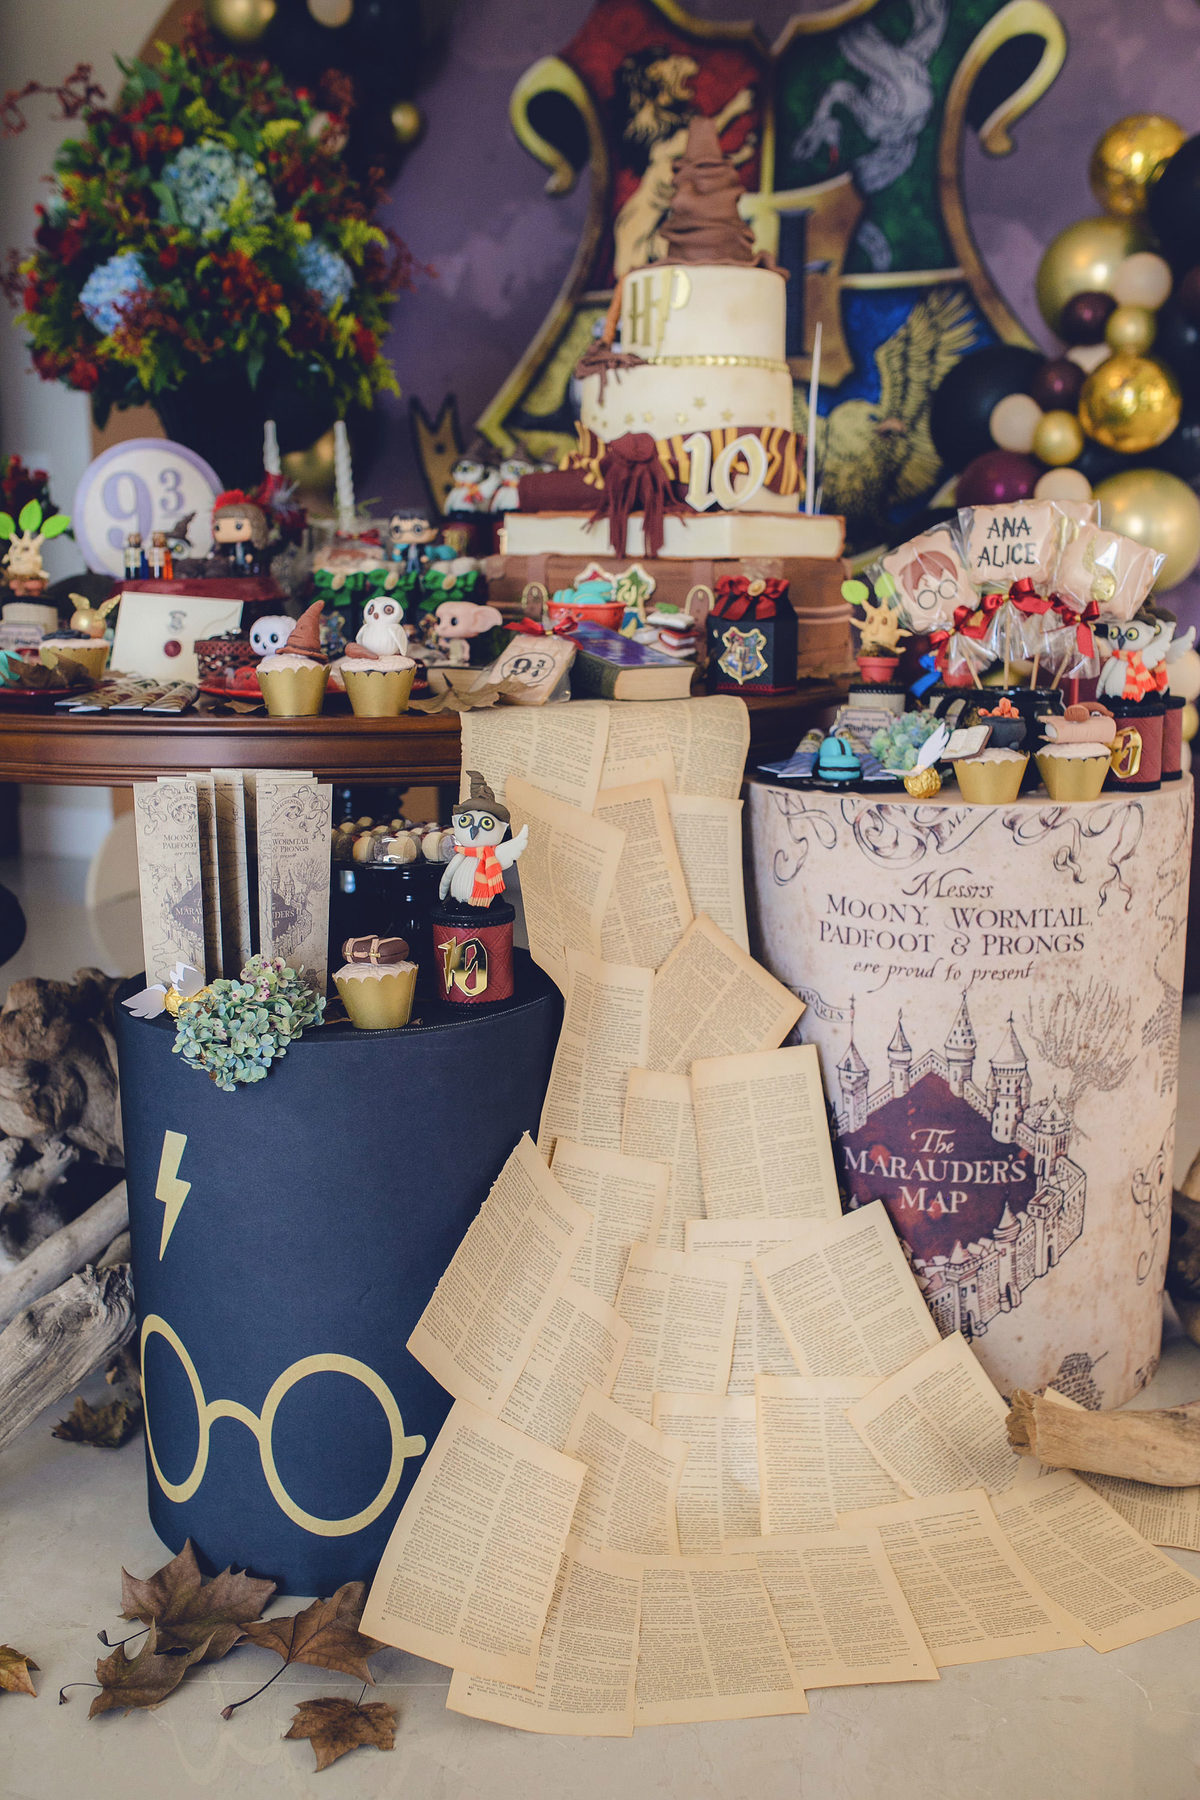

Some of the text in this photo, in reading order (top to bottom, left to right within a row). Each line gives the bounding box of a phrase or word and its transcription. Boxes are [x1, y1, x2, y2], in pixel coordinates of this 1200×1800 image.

[682, 432, 768, 512] 10
[987, 516, 1032, 541] ANA
[977, 543, 1037, 568] ALICE
[818, 920, 1085, 956] PADFOOT & PRONGS
[438, 937, 488, 996] 10
[867, 957, 944, 994] proud
[945, 962, 961, 982] to
[965, 961, 1035, 991] present
[911, 1128, 956, 1153] The
[843, 1146, 1027, 1184] MARAUDER'S
[899, 1186, 968, 1214] MAP
